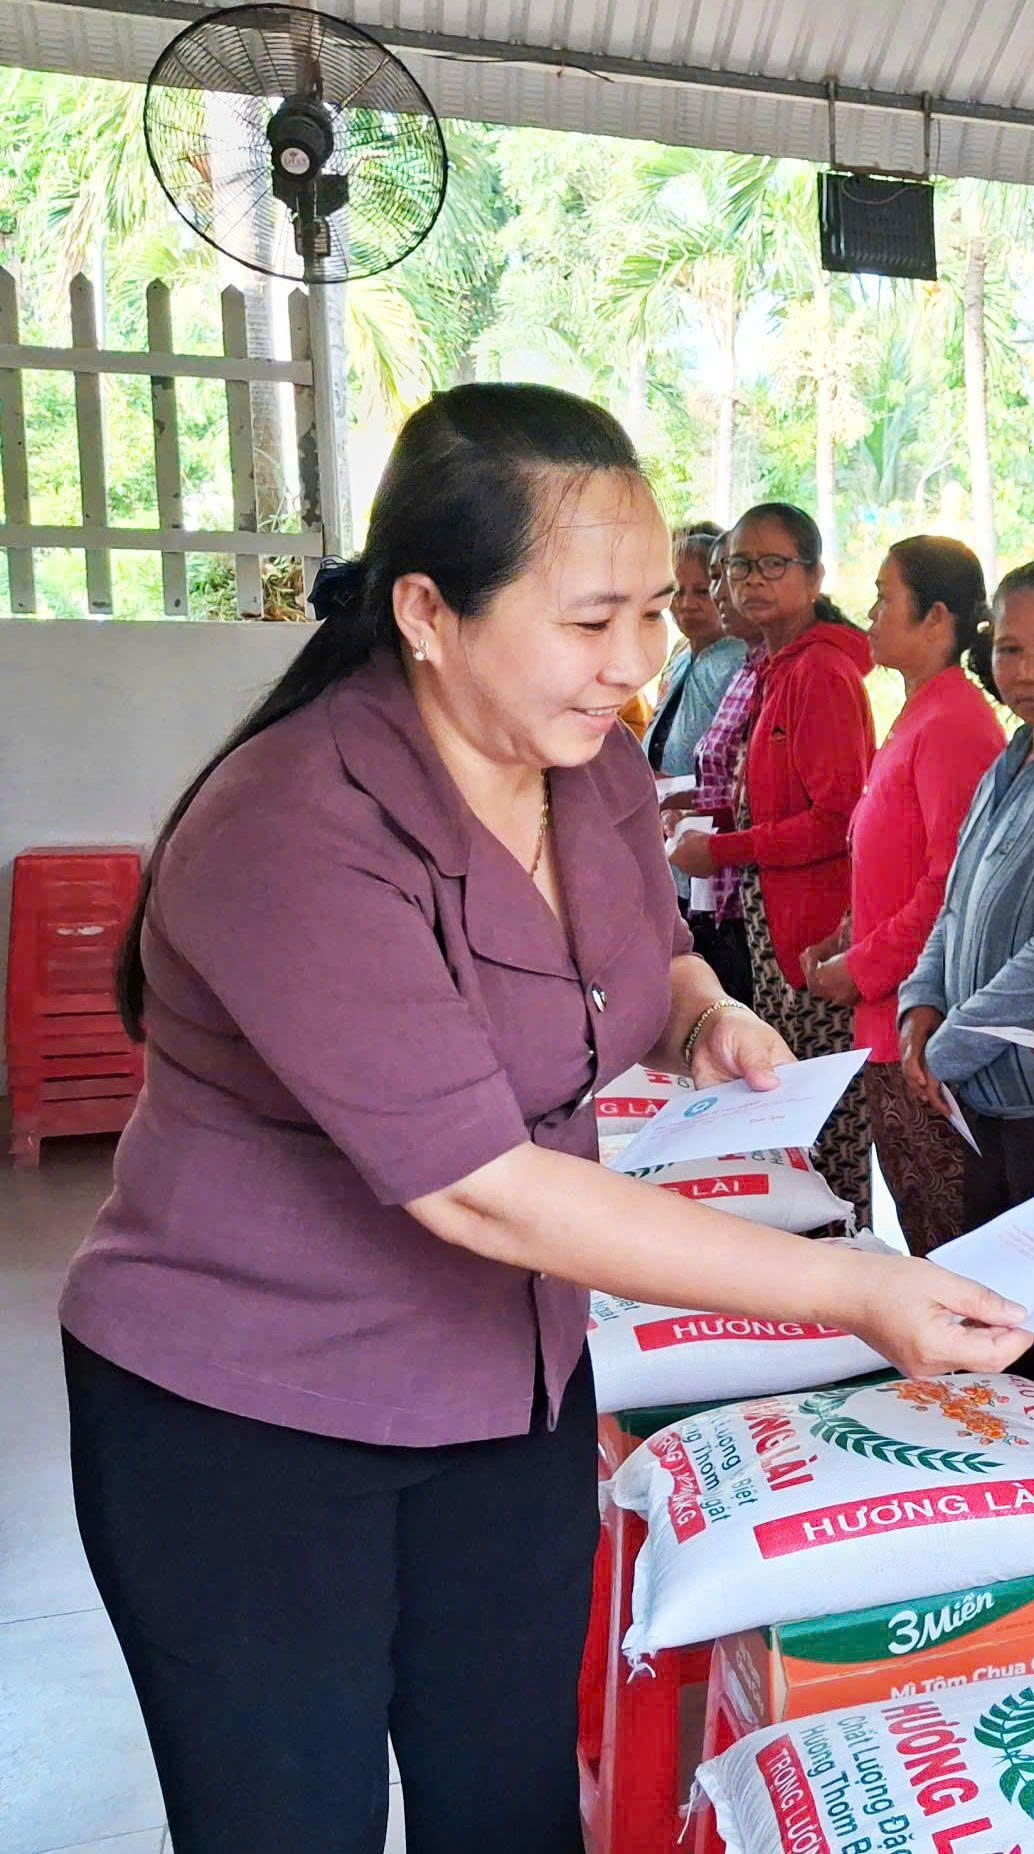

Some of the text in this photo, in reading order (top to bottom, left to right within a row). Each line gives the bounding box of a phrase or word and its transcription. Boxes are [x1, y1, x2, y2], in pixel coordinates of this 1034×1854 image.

[629, 1100, 661, 1114] LÀ
[693, 1179, 739, 1196] LÀI
[672, 1318, 804, 1339] HƯƠNG
[803, 1495, 969, 1541] HƯƠNG
[837, 1715, 879, 1747] Chất
[767, 1748, 804, 1811] TRỌNG
[800, 1724, 837, 1778] Hương
[821, 1770, 858, 1837] Thơm
[853, 1745, 895, 1815] Lượng
[881, 1700, 979, 1817] HƯƠNG
